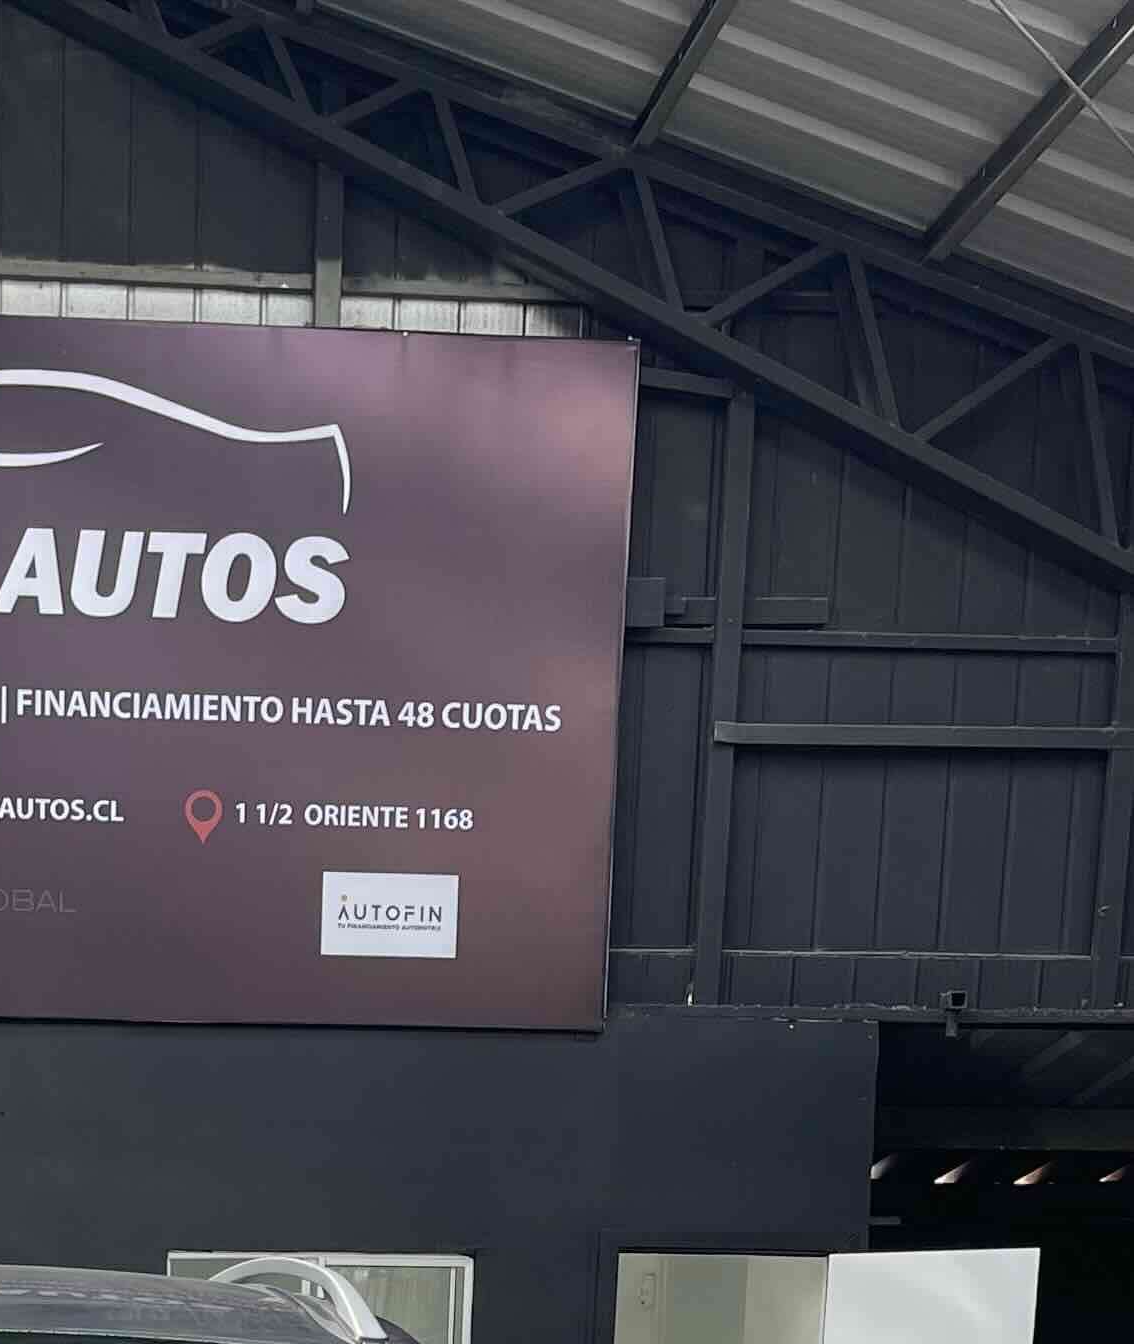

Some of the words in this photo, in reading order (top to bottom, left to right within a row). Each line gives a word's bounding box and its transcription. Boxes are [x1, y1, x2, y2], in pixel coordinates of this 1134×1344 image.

[16, 689, 284, 724] FINANCIAMIENTO
[291, 697, 391, 727] HASTA
[398, 701, 434, 728] 48
[441, 703, 562, 732] CUOTAS
[235, 803, 246, 823] 1
[256, 803, 293, 826] 1/2
[304, 804, 409, 829] ORIENTE
[416, 807, 474, 830] 1168
[338, 904, 442, 922] AUTOFIN
